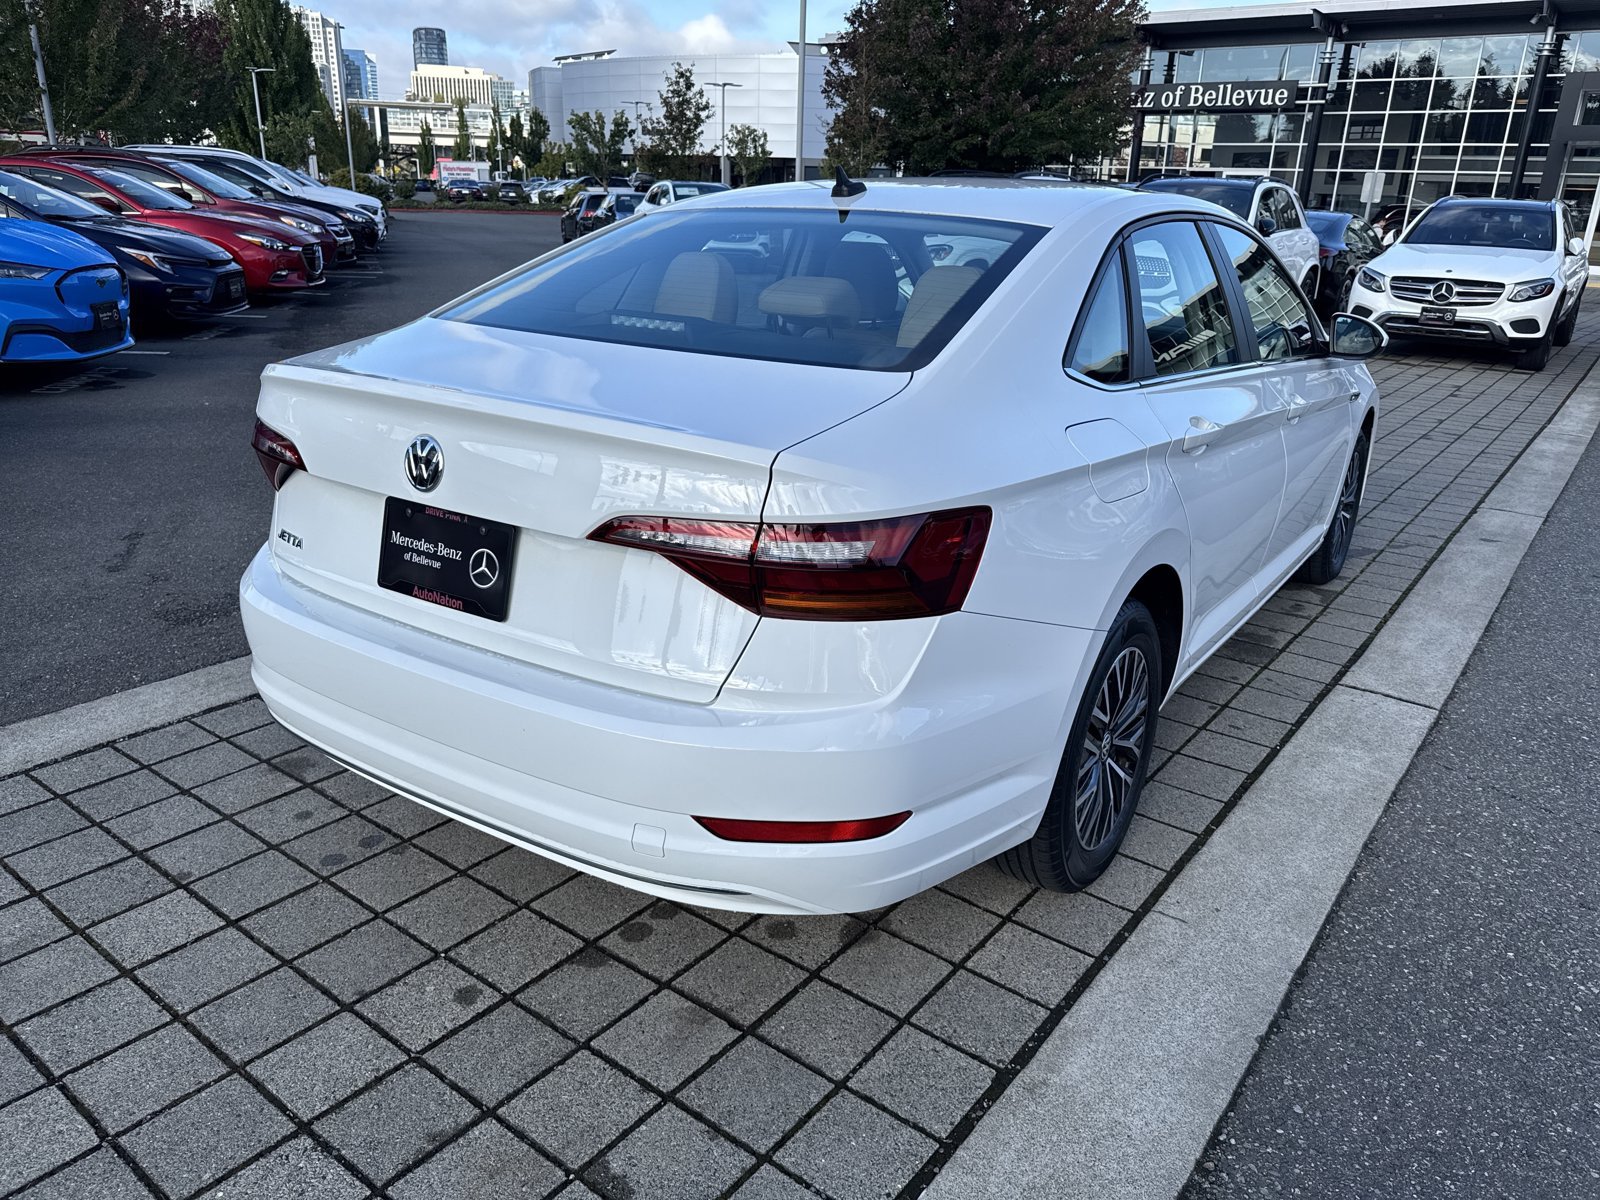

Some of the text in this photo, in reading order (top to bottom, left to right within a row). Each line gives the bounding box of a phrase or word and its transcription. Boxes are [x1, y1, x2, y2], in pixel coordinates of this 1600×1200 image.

[1161, 85, 1185, 108] of
[1187, 83, 1289, 107] Bellevue
[425, 506, 444, 518] DRIVE
[278, 528, 304, 550] JETTA
[390, 530, 462, 561] Mercedes-Benz
[403, 551, 442, 569] of Bellevue
[412, 585, 463, 610] AutoNation
